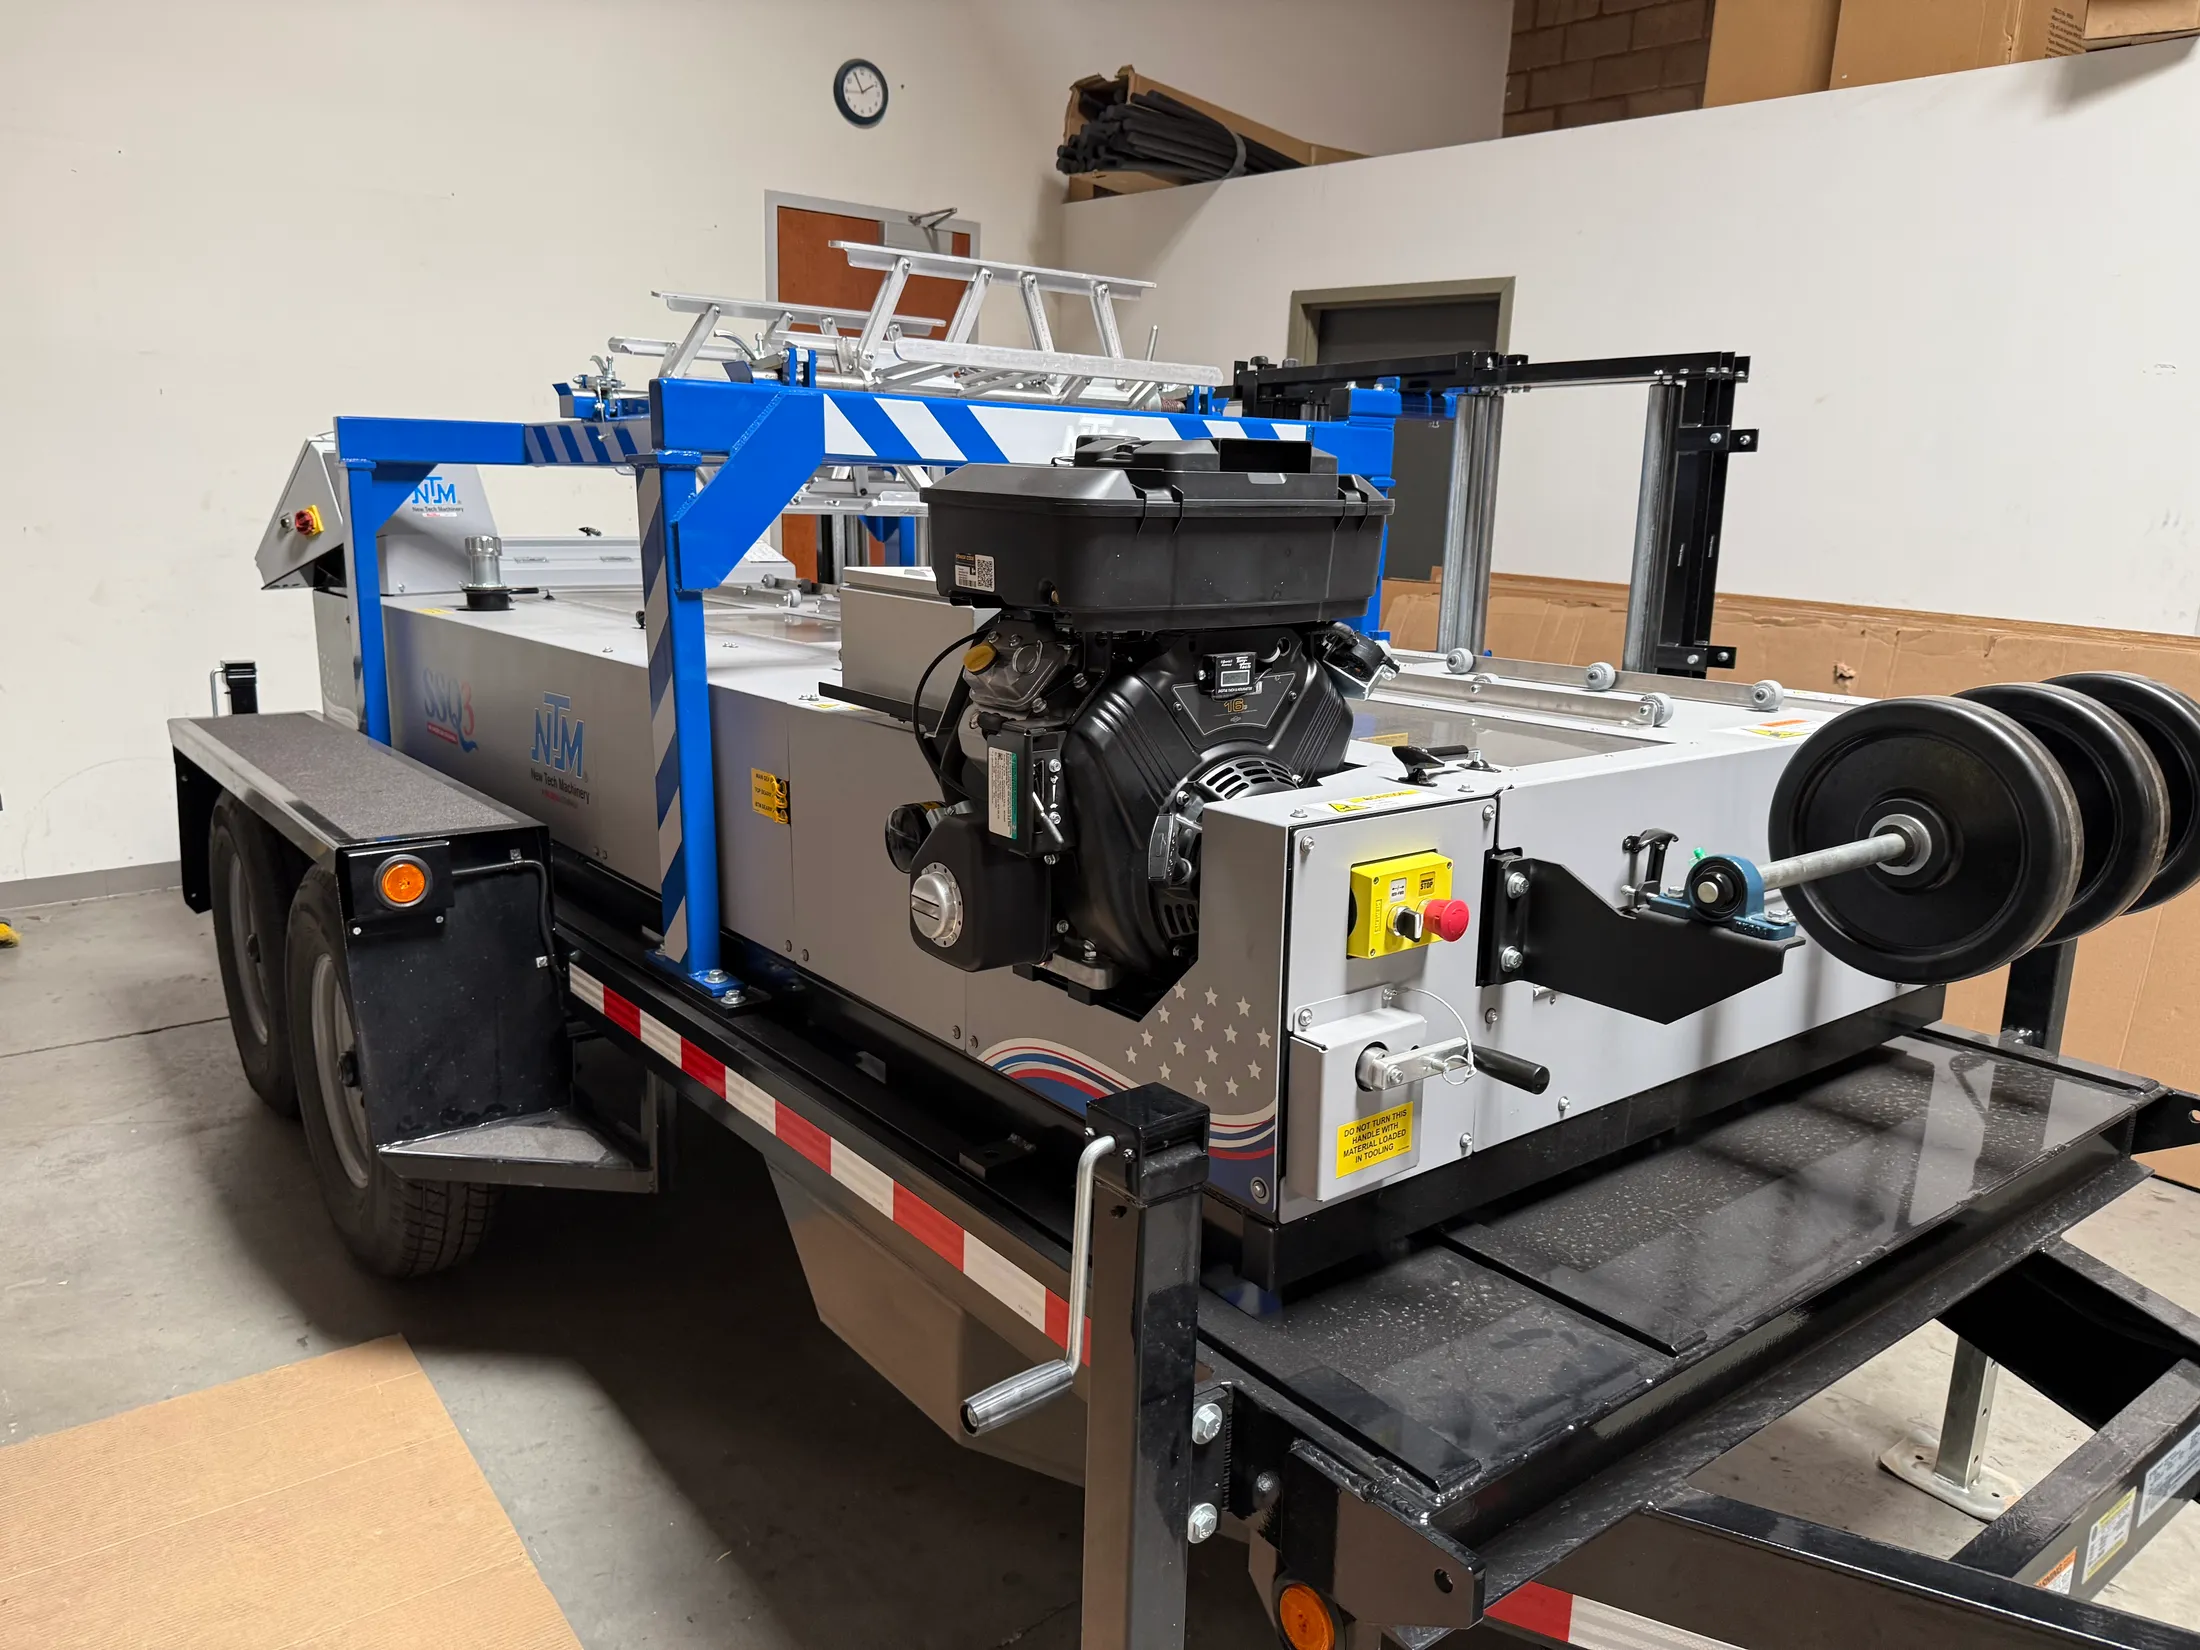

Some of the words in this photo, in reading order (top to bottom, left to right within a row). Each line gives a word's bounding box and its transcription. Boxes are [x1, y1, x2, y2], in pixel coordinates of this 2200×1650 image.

[412, 476, 457, 504] NTM
[1224, 698, 1244, 713] 16
[531, 691, 584, 779] NTM
[530, 767, 543, 782] New
[543, 772, 558, 789] Tech
[558, 777, 590, 805] Machinery
[1420, 881, 1434, 890] STOP
[1344, 1127, 1355, 1138] DO
[1356, 1121, 1371, 1134] NOT
[1372, 1114, 1391, 1128] TURN
[1392, 1109, 1407, 1120] THIS
[1352, 1128, 1380, 1145] HANDLE
[1382, 1122, 1399, 1134] WITH
[1343, 1140, 1378, 1158] MATERIAL
[1379, 1128, 1407, 1145] LOADED
[1355, 1154, 1363, 1164] IN
[1364, 1143, 1394, 1159] TOOLING
